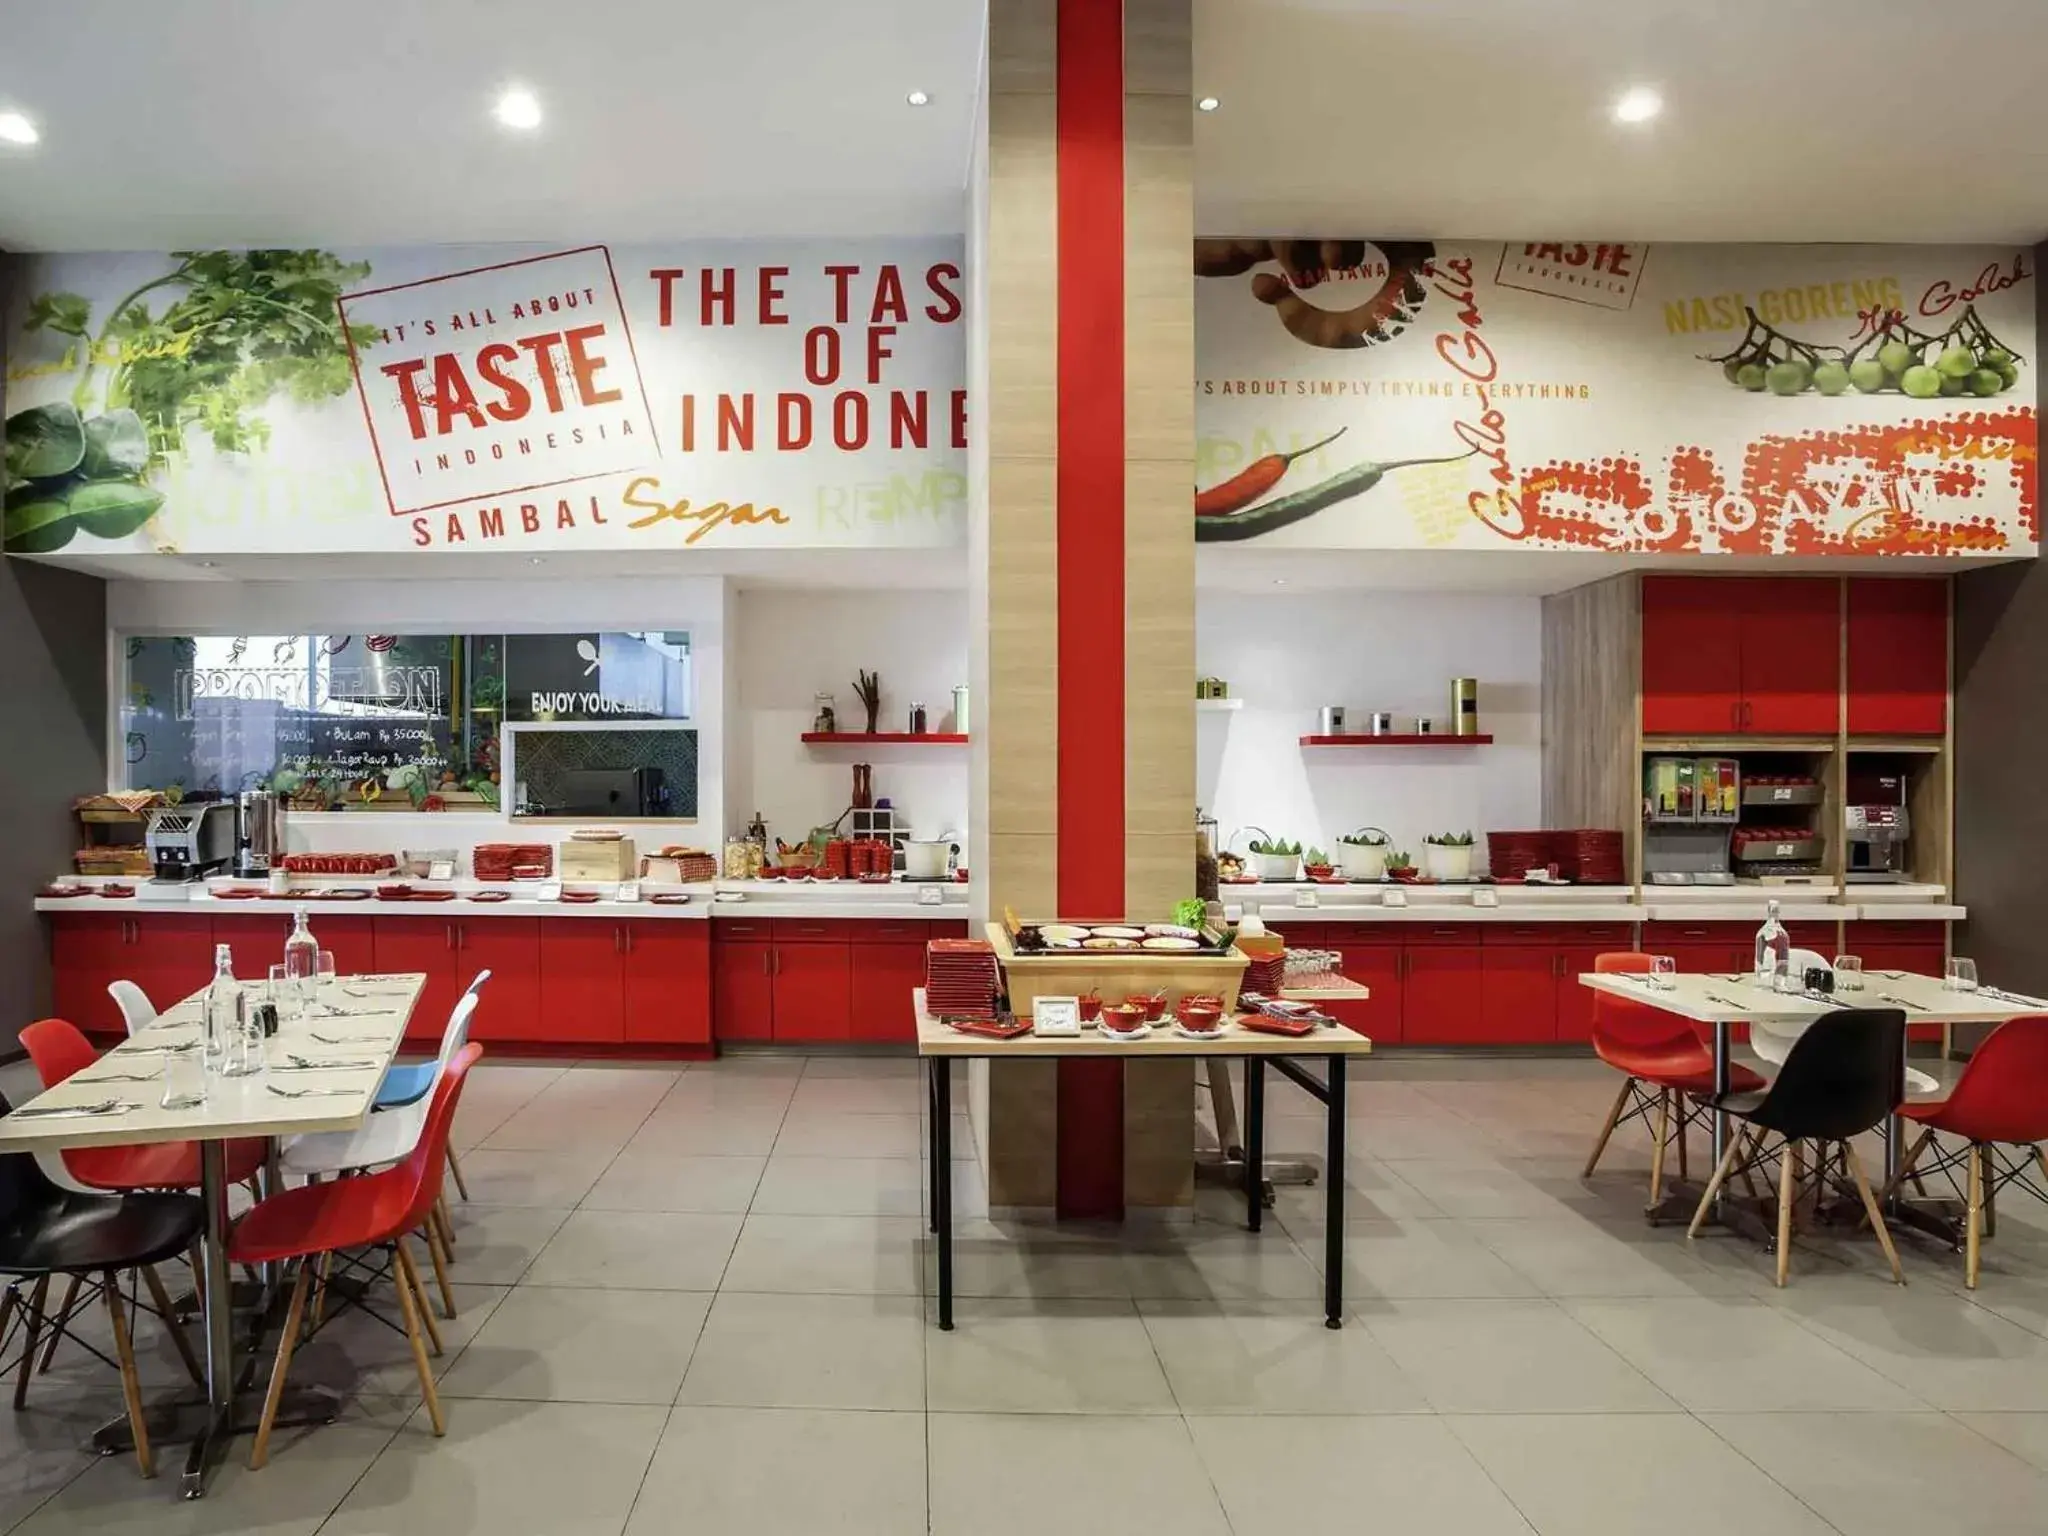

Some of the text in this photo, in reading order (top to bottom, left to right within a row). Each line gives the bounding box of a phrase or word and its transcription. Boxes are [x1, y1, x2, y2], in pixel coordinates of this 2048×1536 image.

[650, 263, 962, 327] THE TAS
[1515, 263, 1626, 294] INDONESIA
[1665, 276, 1905, 336] NASI GORENG
[381, 288, 595, 345] IT'S ALL ABOUT
[380, 323, 623, 440] TASTE
[804, 326, 897, 386] OF
[1222, 380, 1288, 395] ABOUT
[1297, 380, 1372, 396] SIMPLY
[1380, 381, 1454, 397] TRYING
[1462, 383, 1590, 400] EVERYTHING
[414, 418, 634, 475] INDONESIA
[411, 495, 609, 546] SAMBAL
[622, 476, 790, 544] Segar
[181, 668, 438, 717] PROMOTION
[531, 692, 577, 713] ENJOY
[579, 692, 621, 713] YOUR
